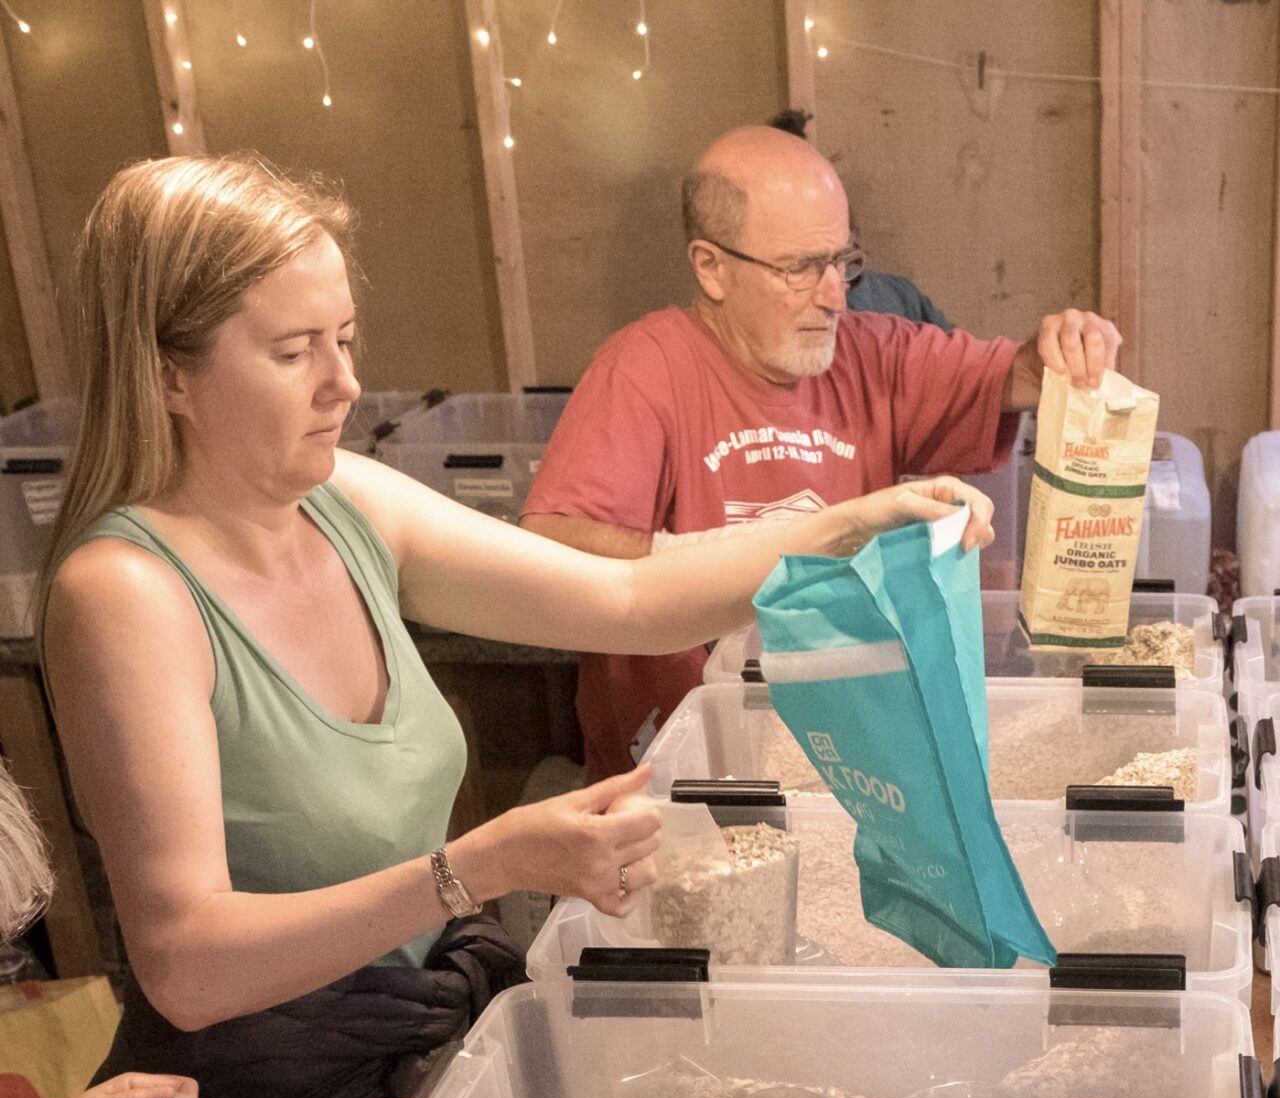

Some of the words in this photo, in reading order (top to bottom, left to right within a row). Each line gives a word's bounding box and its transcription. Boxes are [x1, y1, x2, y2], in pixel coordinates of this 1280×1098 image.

[1066, 548, 1116, 559] ORGANIC
[1054, 554, 1095, 568] JUMBO
[1097, 559, 1127, 569] OATS
[840, 766, 906, 813] FOOD
